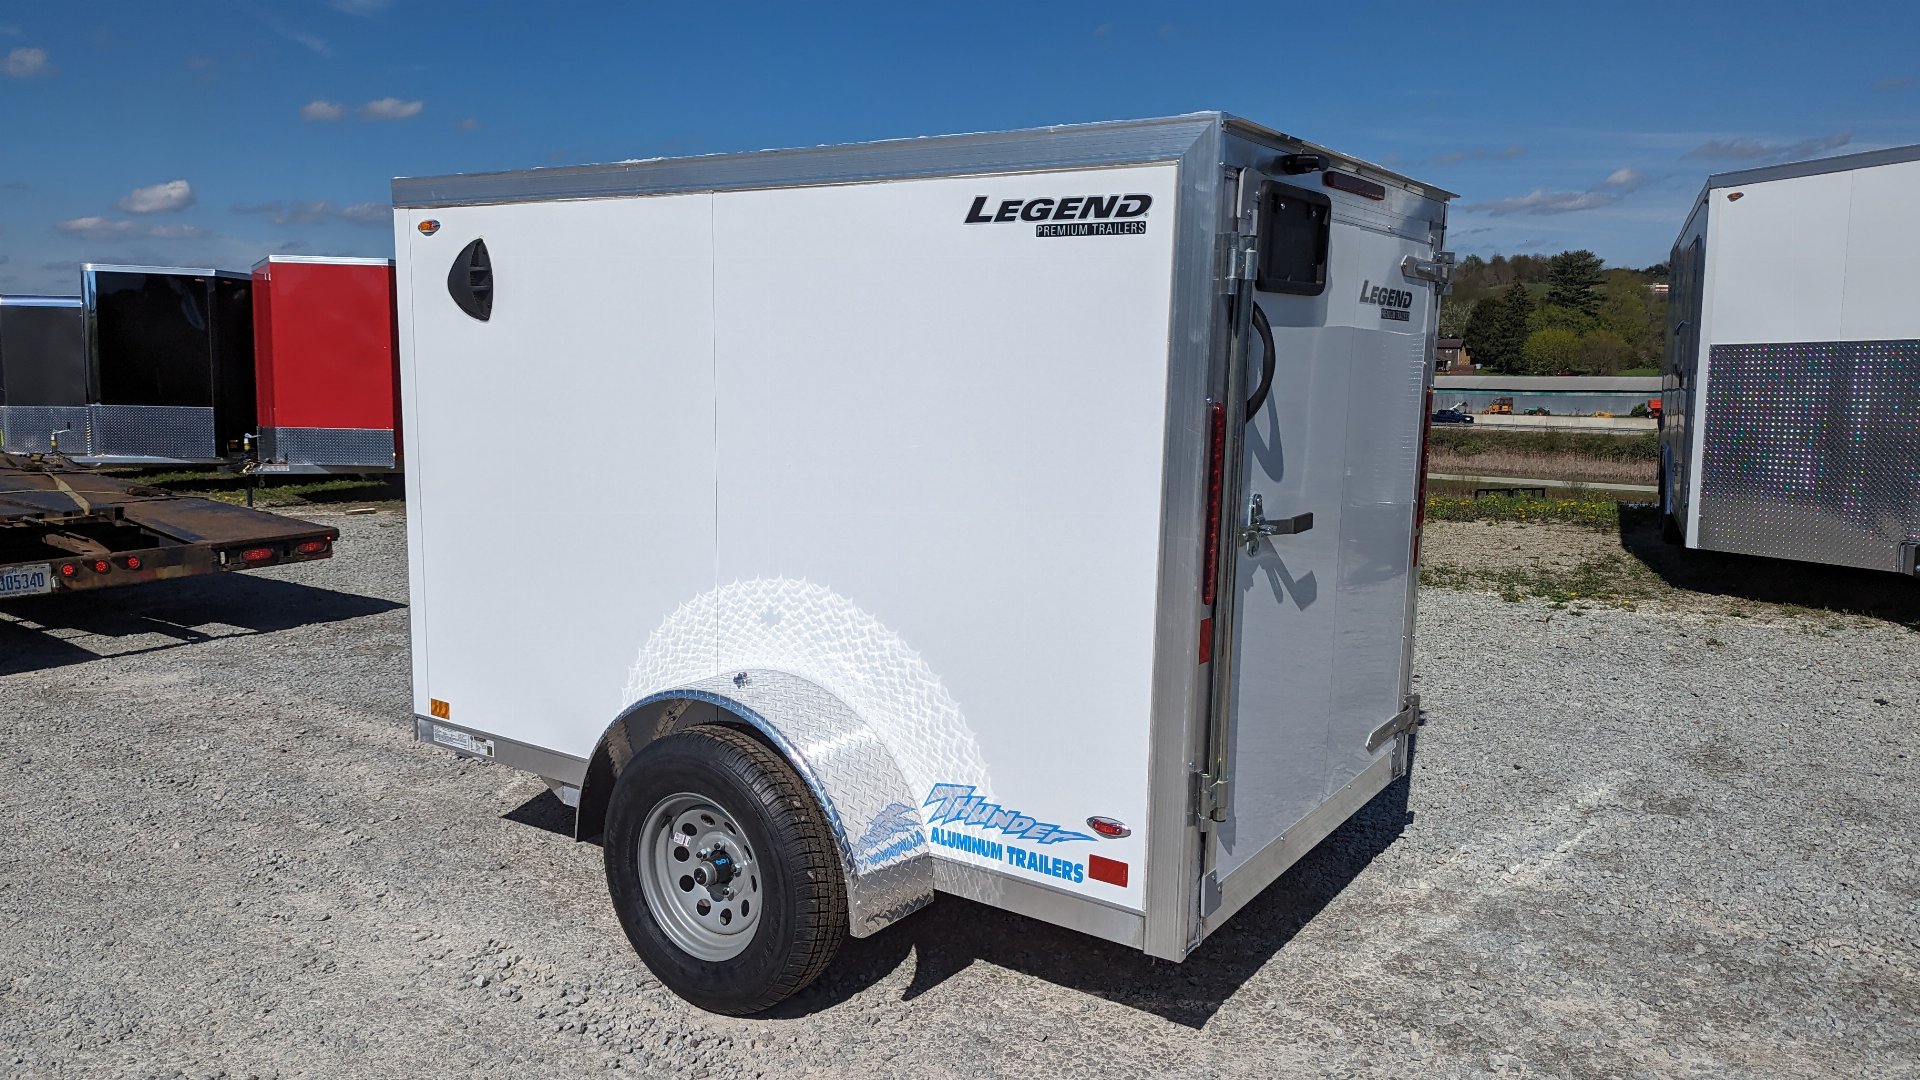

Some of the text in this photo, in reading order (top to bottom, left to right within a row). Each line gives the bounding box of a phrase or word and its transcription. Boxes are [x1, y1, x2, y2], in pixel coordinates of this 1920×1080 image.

[964, 194, 1153, 224] LEGEND
[1036, 221, 1145, 236] PREMIUM TRAILERS
[1359, 280, 1412, 308] LEGEND
[930, 827, 1003, 861] ALUMINUM
[1007, 846, 1084, 883] TRAILERS
